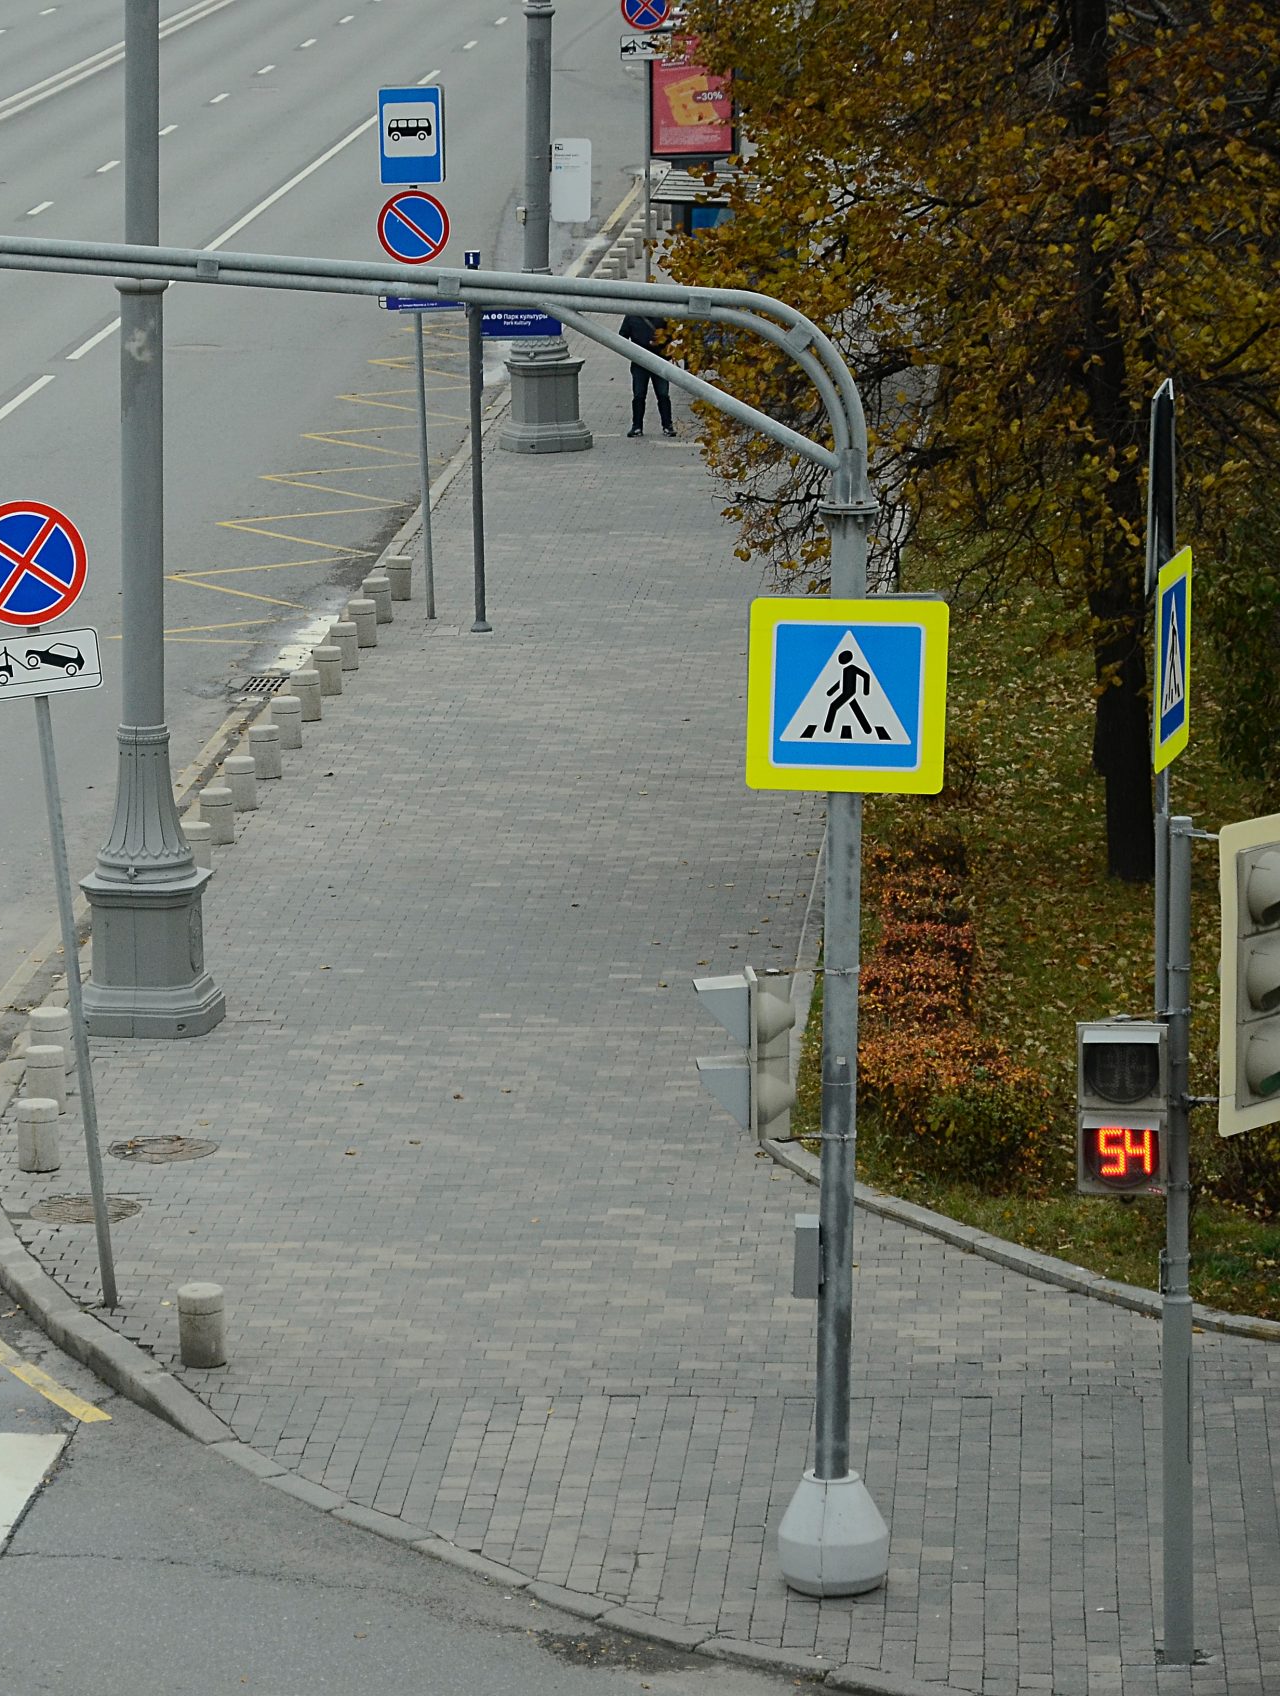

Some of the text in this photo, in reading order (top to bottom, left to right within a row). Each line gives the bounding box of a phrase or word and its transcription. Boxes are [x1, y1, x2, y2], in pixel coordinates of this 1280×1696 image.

[696, 91, 723, 101] -30%
[503, 313, 519, 321] Парк
[1099, 1128, 1152, 1176] 54
